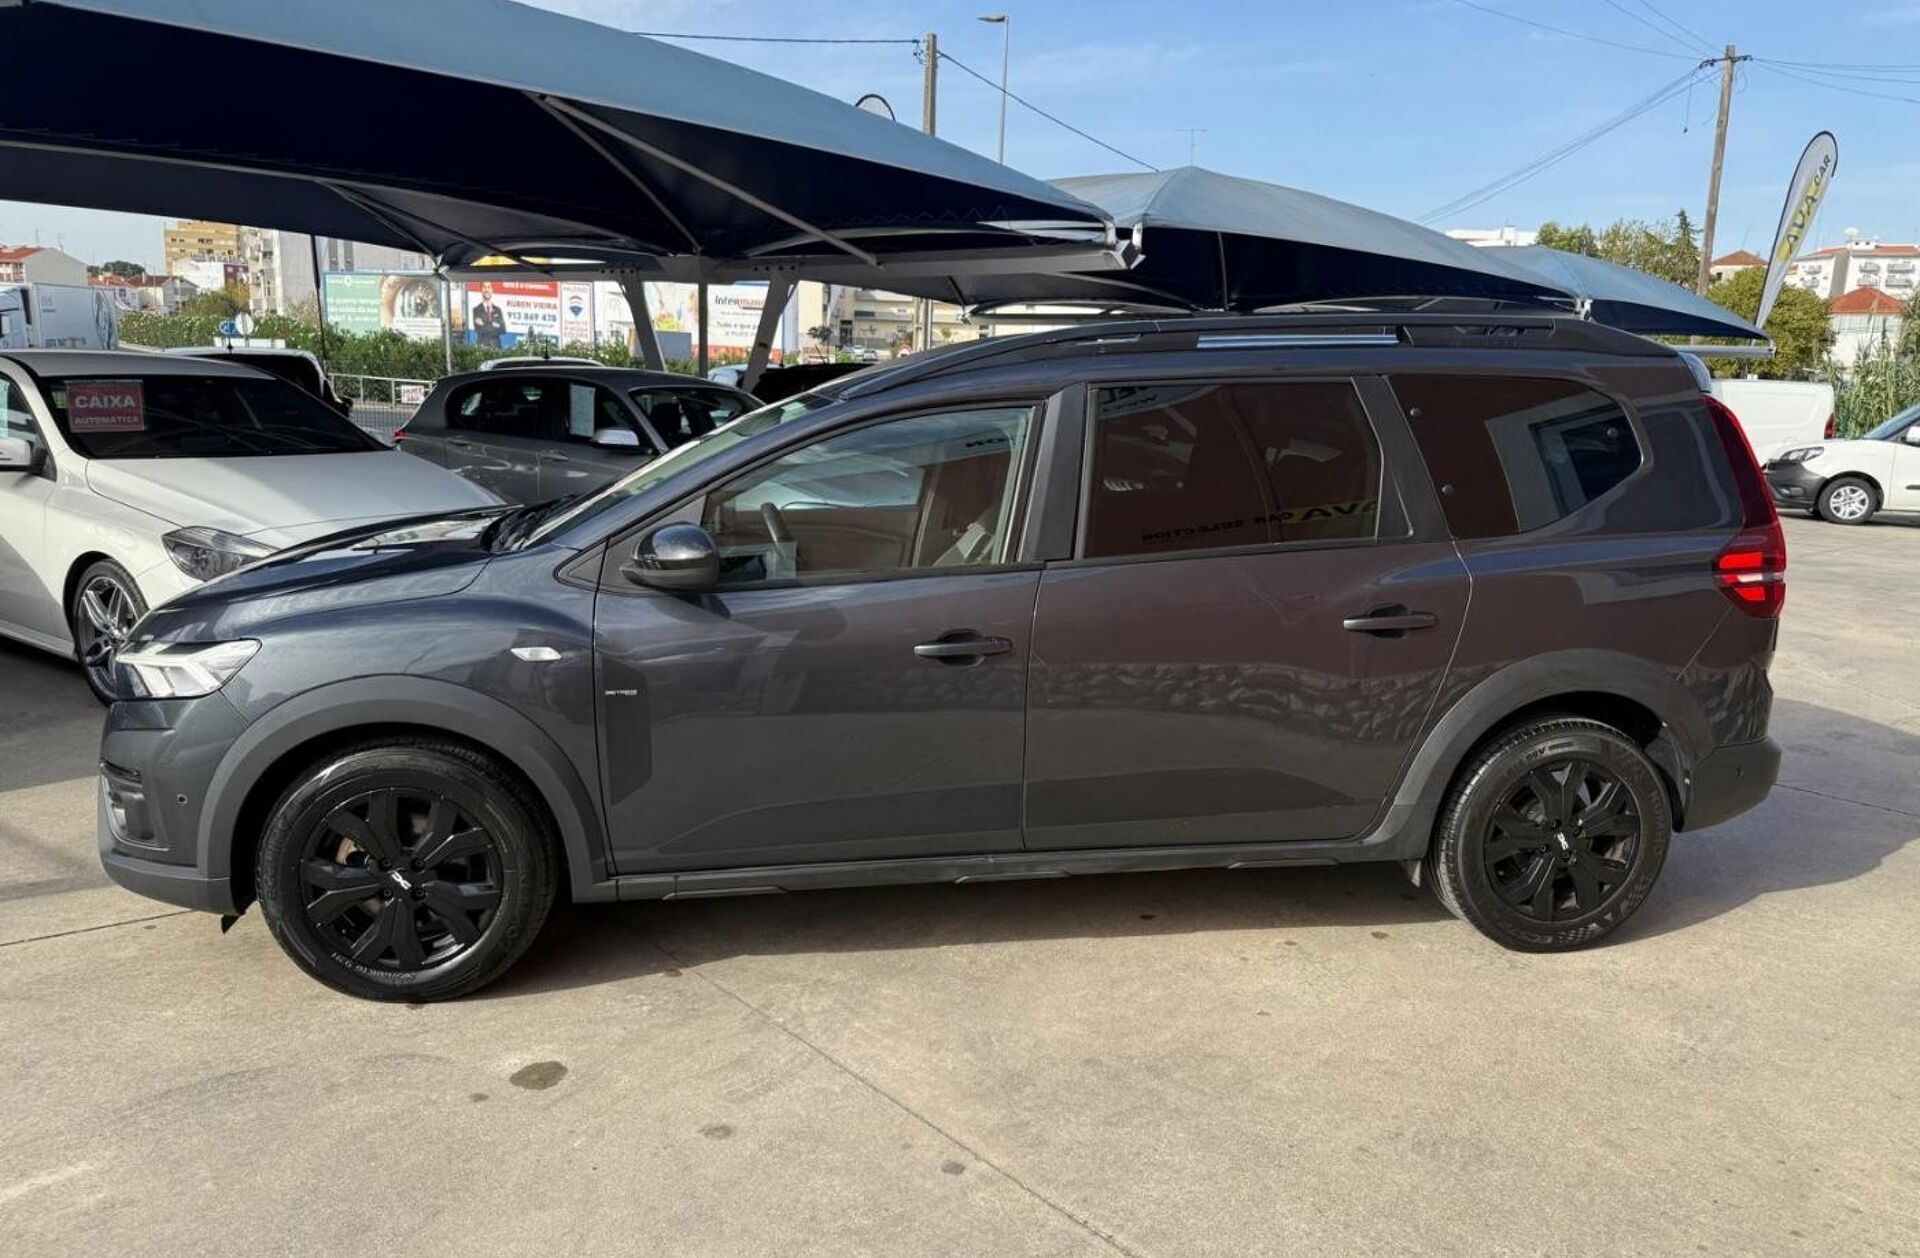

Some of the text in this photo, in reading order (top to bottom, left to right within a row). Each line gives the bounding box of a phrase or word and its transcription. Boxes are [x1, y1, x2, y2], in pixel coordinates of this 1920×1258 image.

[1813, 154, 1832, 185] CAR
[506, 299, 558, 311] RUBEN VIEIRA
[74, 393, 137, 409] CAIXA
